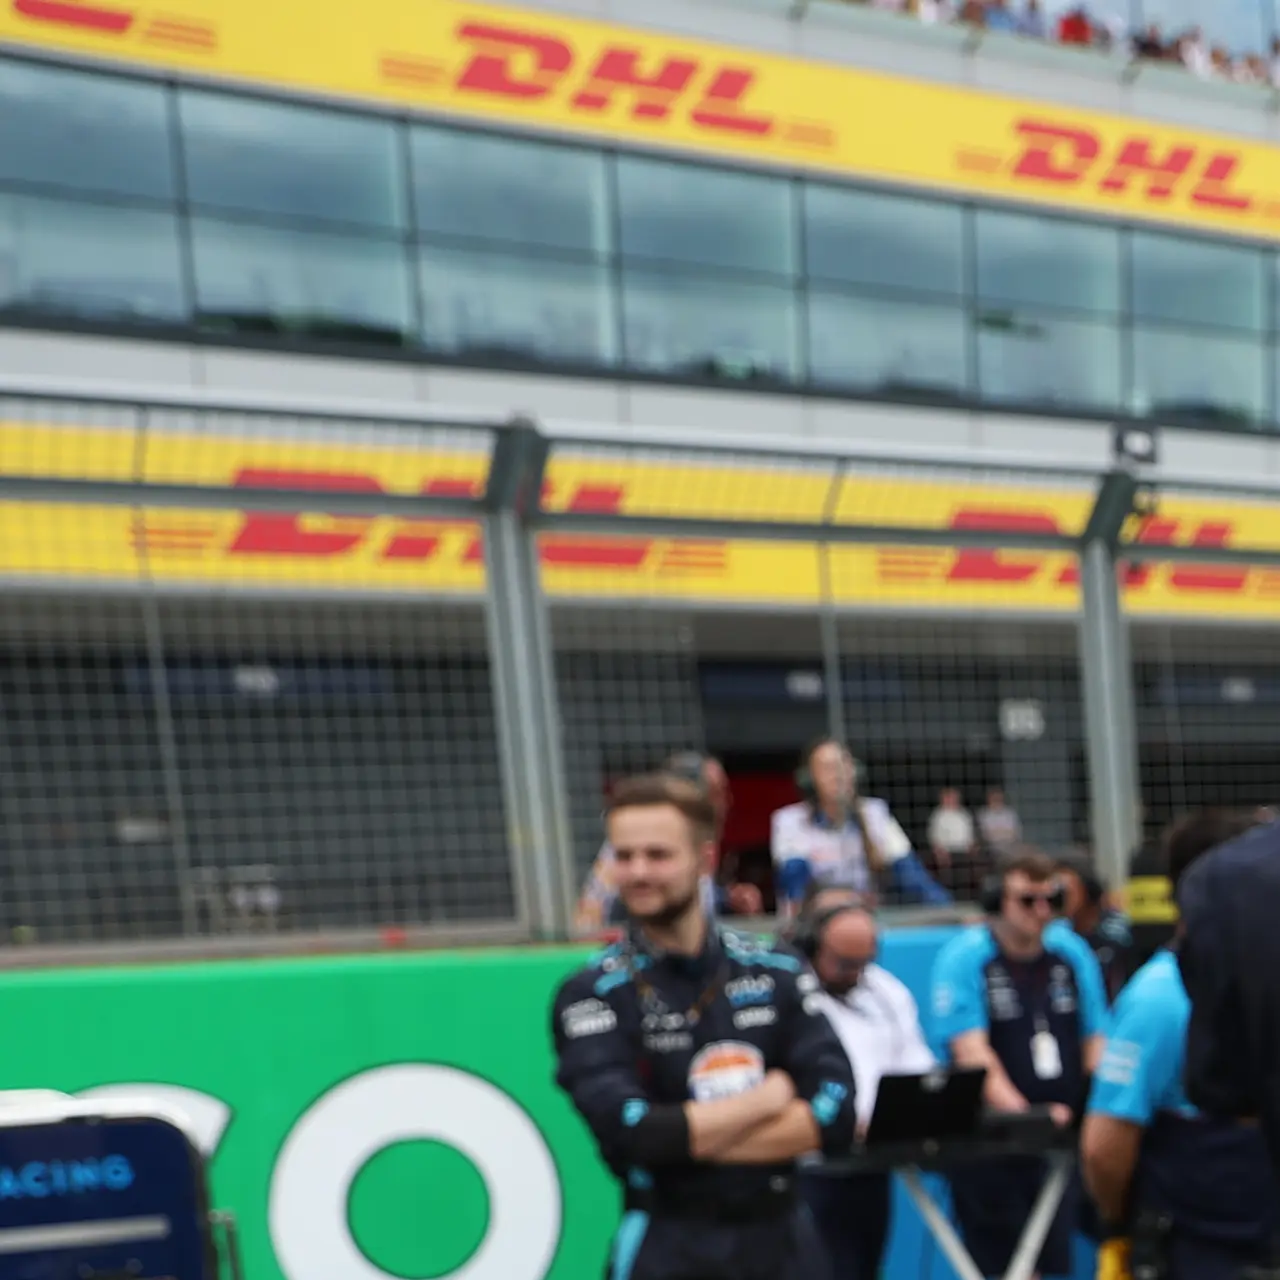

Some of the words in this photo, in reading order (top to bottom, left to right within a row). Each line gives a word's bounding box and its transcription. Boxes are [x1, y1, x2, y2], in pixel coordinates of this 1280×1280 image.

[454, 21, 775, 136] DHL
[1011, 119, 1253, 212] DHL
[0, 1153, 136, 1199] ACING
